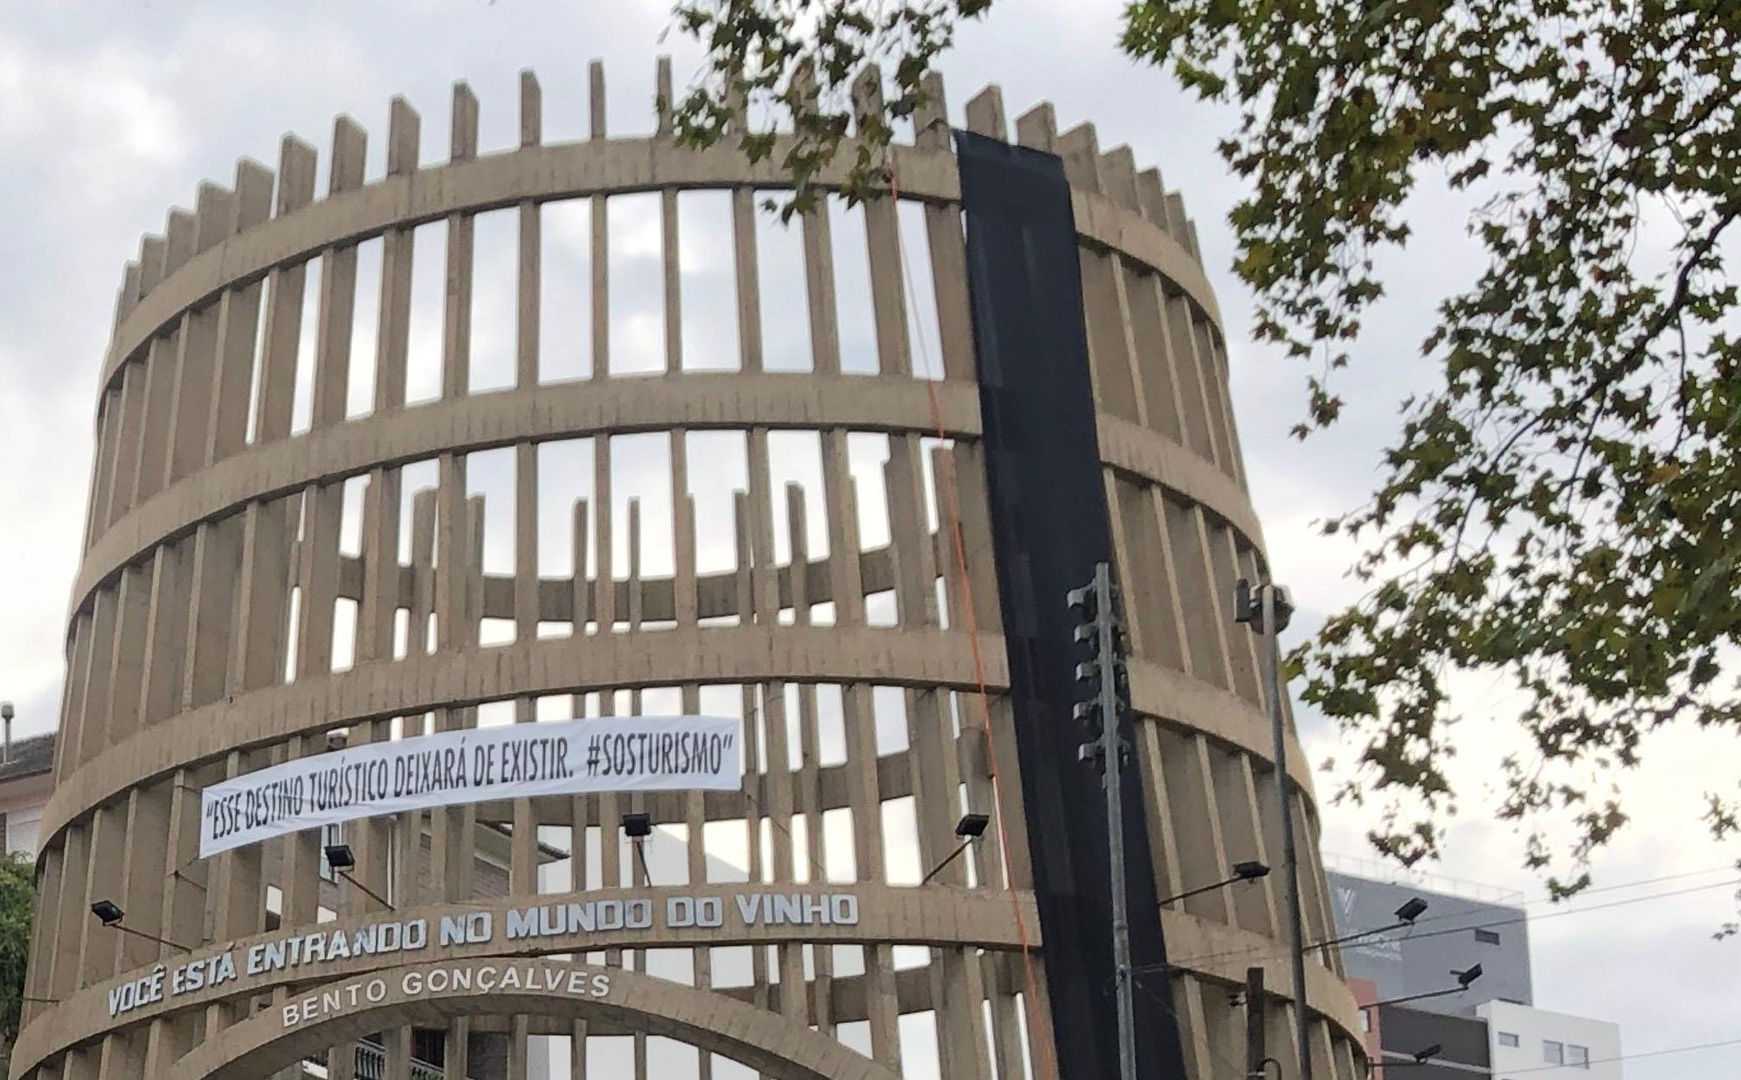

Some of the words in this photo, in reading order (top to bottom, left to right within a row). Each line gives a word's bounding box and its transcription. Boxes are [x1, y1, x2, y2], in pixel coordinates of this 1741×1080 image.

[246, 775, 303, 829] DESTINO
[310, 756, 388, 811] TURÍSTICO
[394, 737, 467, 797] DEIXARÁ
[473, 744, 495, 787] DE
[501, 736, 574, 783] EXISTIR.
[109, 963, 167, 1017] VOCÊ
[172, 942, 237, 995] ESTÁ
[246, 917, 428, 977] ENTRANDO
[440, 911, 492, 947] NO
[506, 897, 653, 940] MUNDO
[667, 896, 723, 928] DO
[735, 893, 859, 926] VINHO
[282, 979, 386, 1028] BENTO
[402, 966, 611, 998] GONÇALVES
